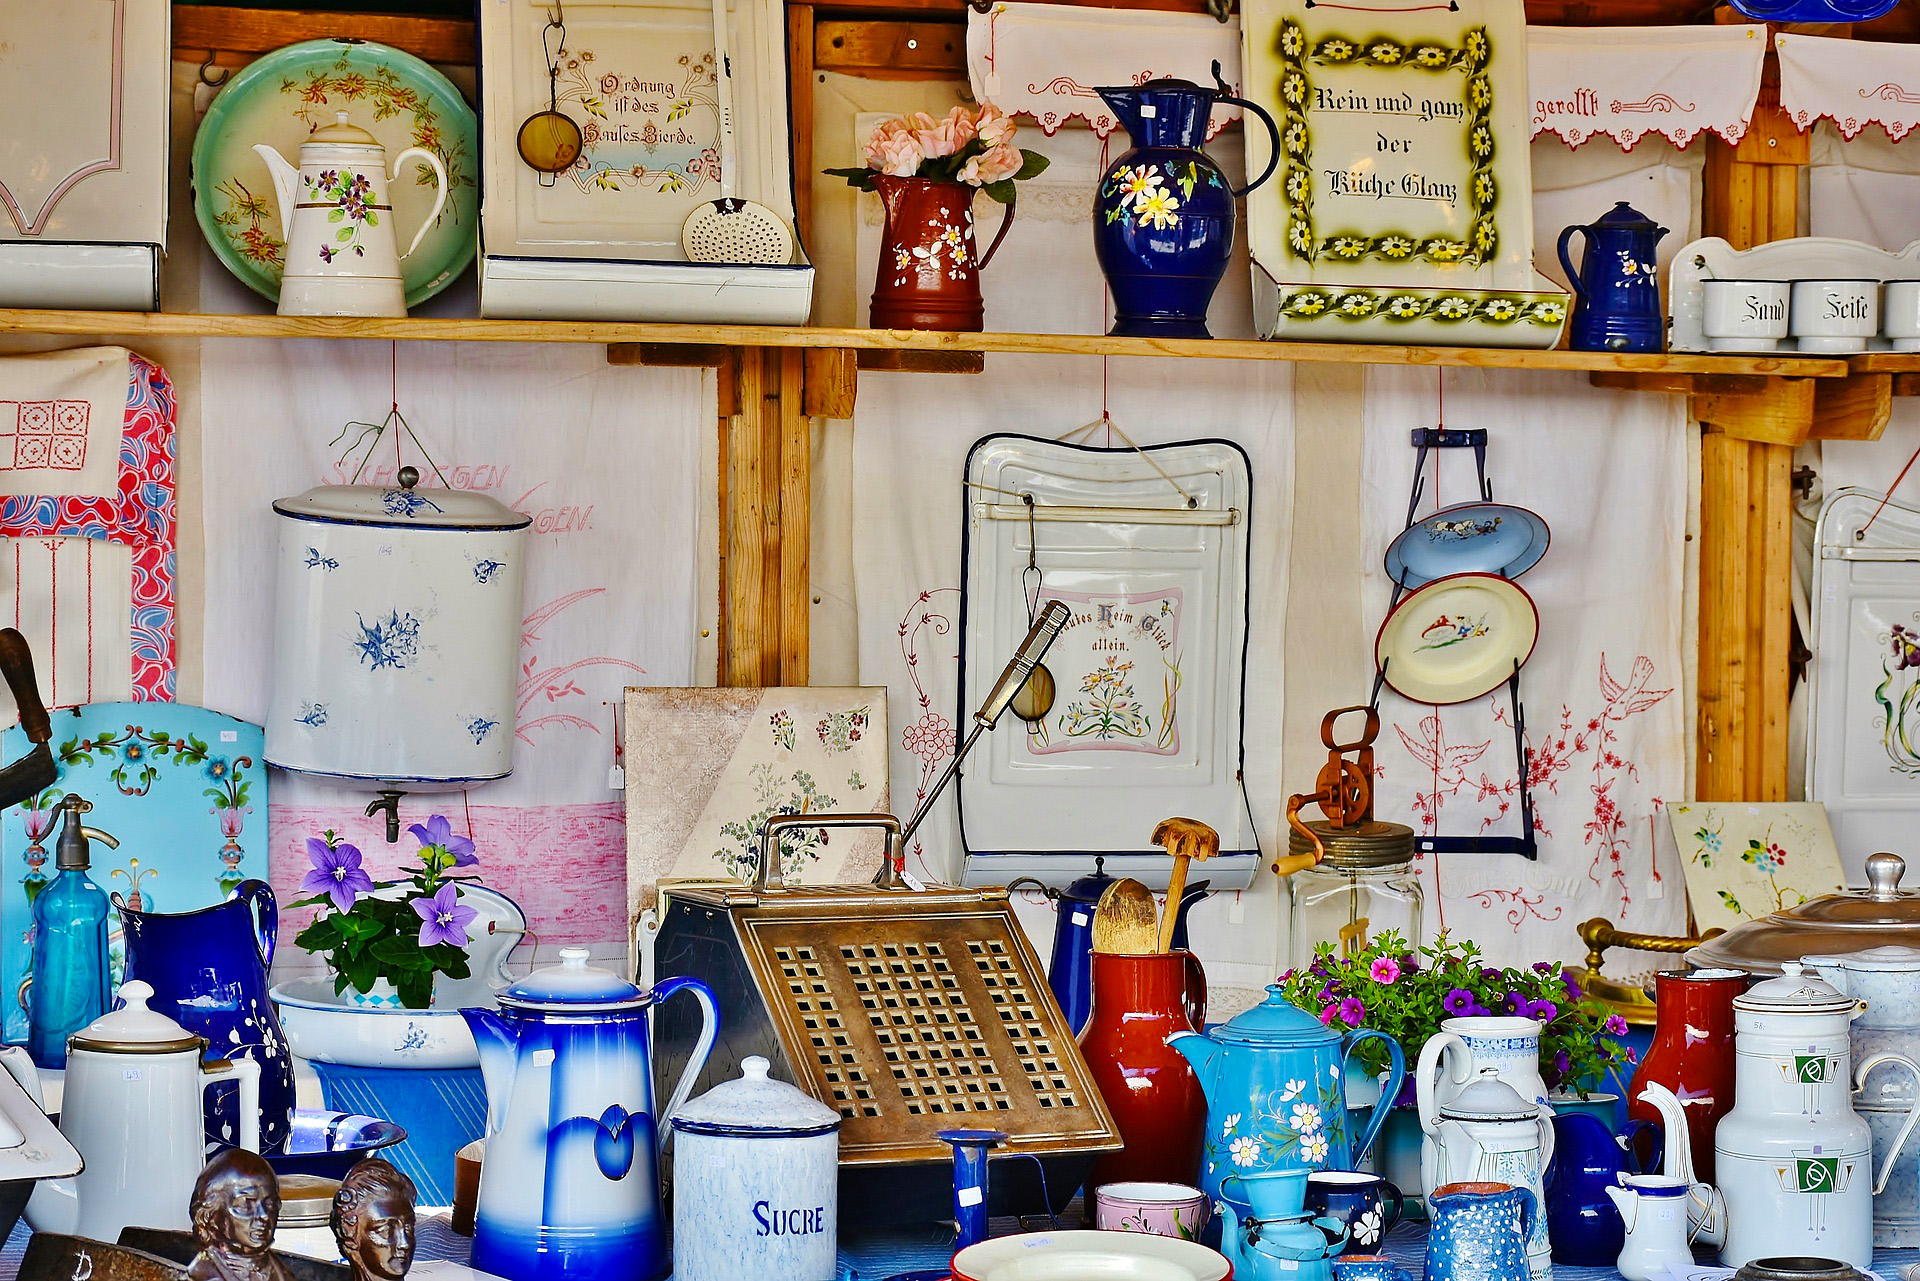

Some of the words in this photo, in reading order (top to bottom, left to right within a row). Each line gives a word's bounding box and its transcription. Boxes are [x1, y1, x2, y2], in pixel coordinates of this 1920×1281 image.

[600, 74, 676, 100] Ordnung
[631, 97, 660, 114] des
[1313, 86, 1370, 111] Rein
[1375, 91, 1413, 112] und
[1418, 99, 1465, 124] ganz
[1532, 87, 1599, 124] gerollt
[1375, 131, 1412, 154] der
[1323, 169, 1396, 201] Küche
[1401, 172, 1458, 209] Glanz
[1741, 295, 1785, 323] Sand
[1823, 293, 1869, 323] Seife
[1091, 638, 1130, 651] allein.
[751, 1200, 824, 1237] SUCRE
